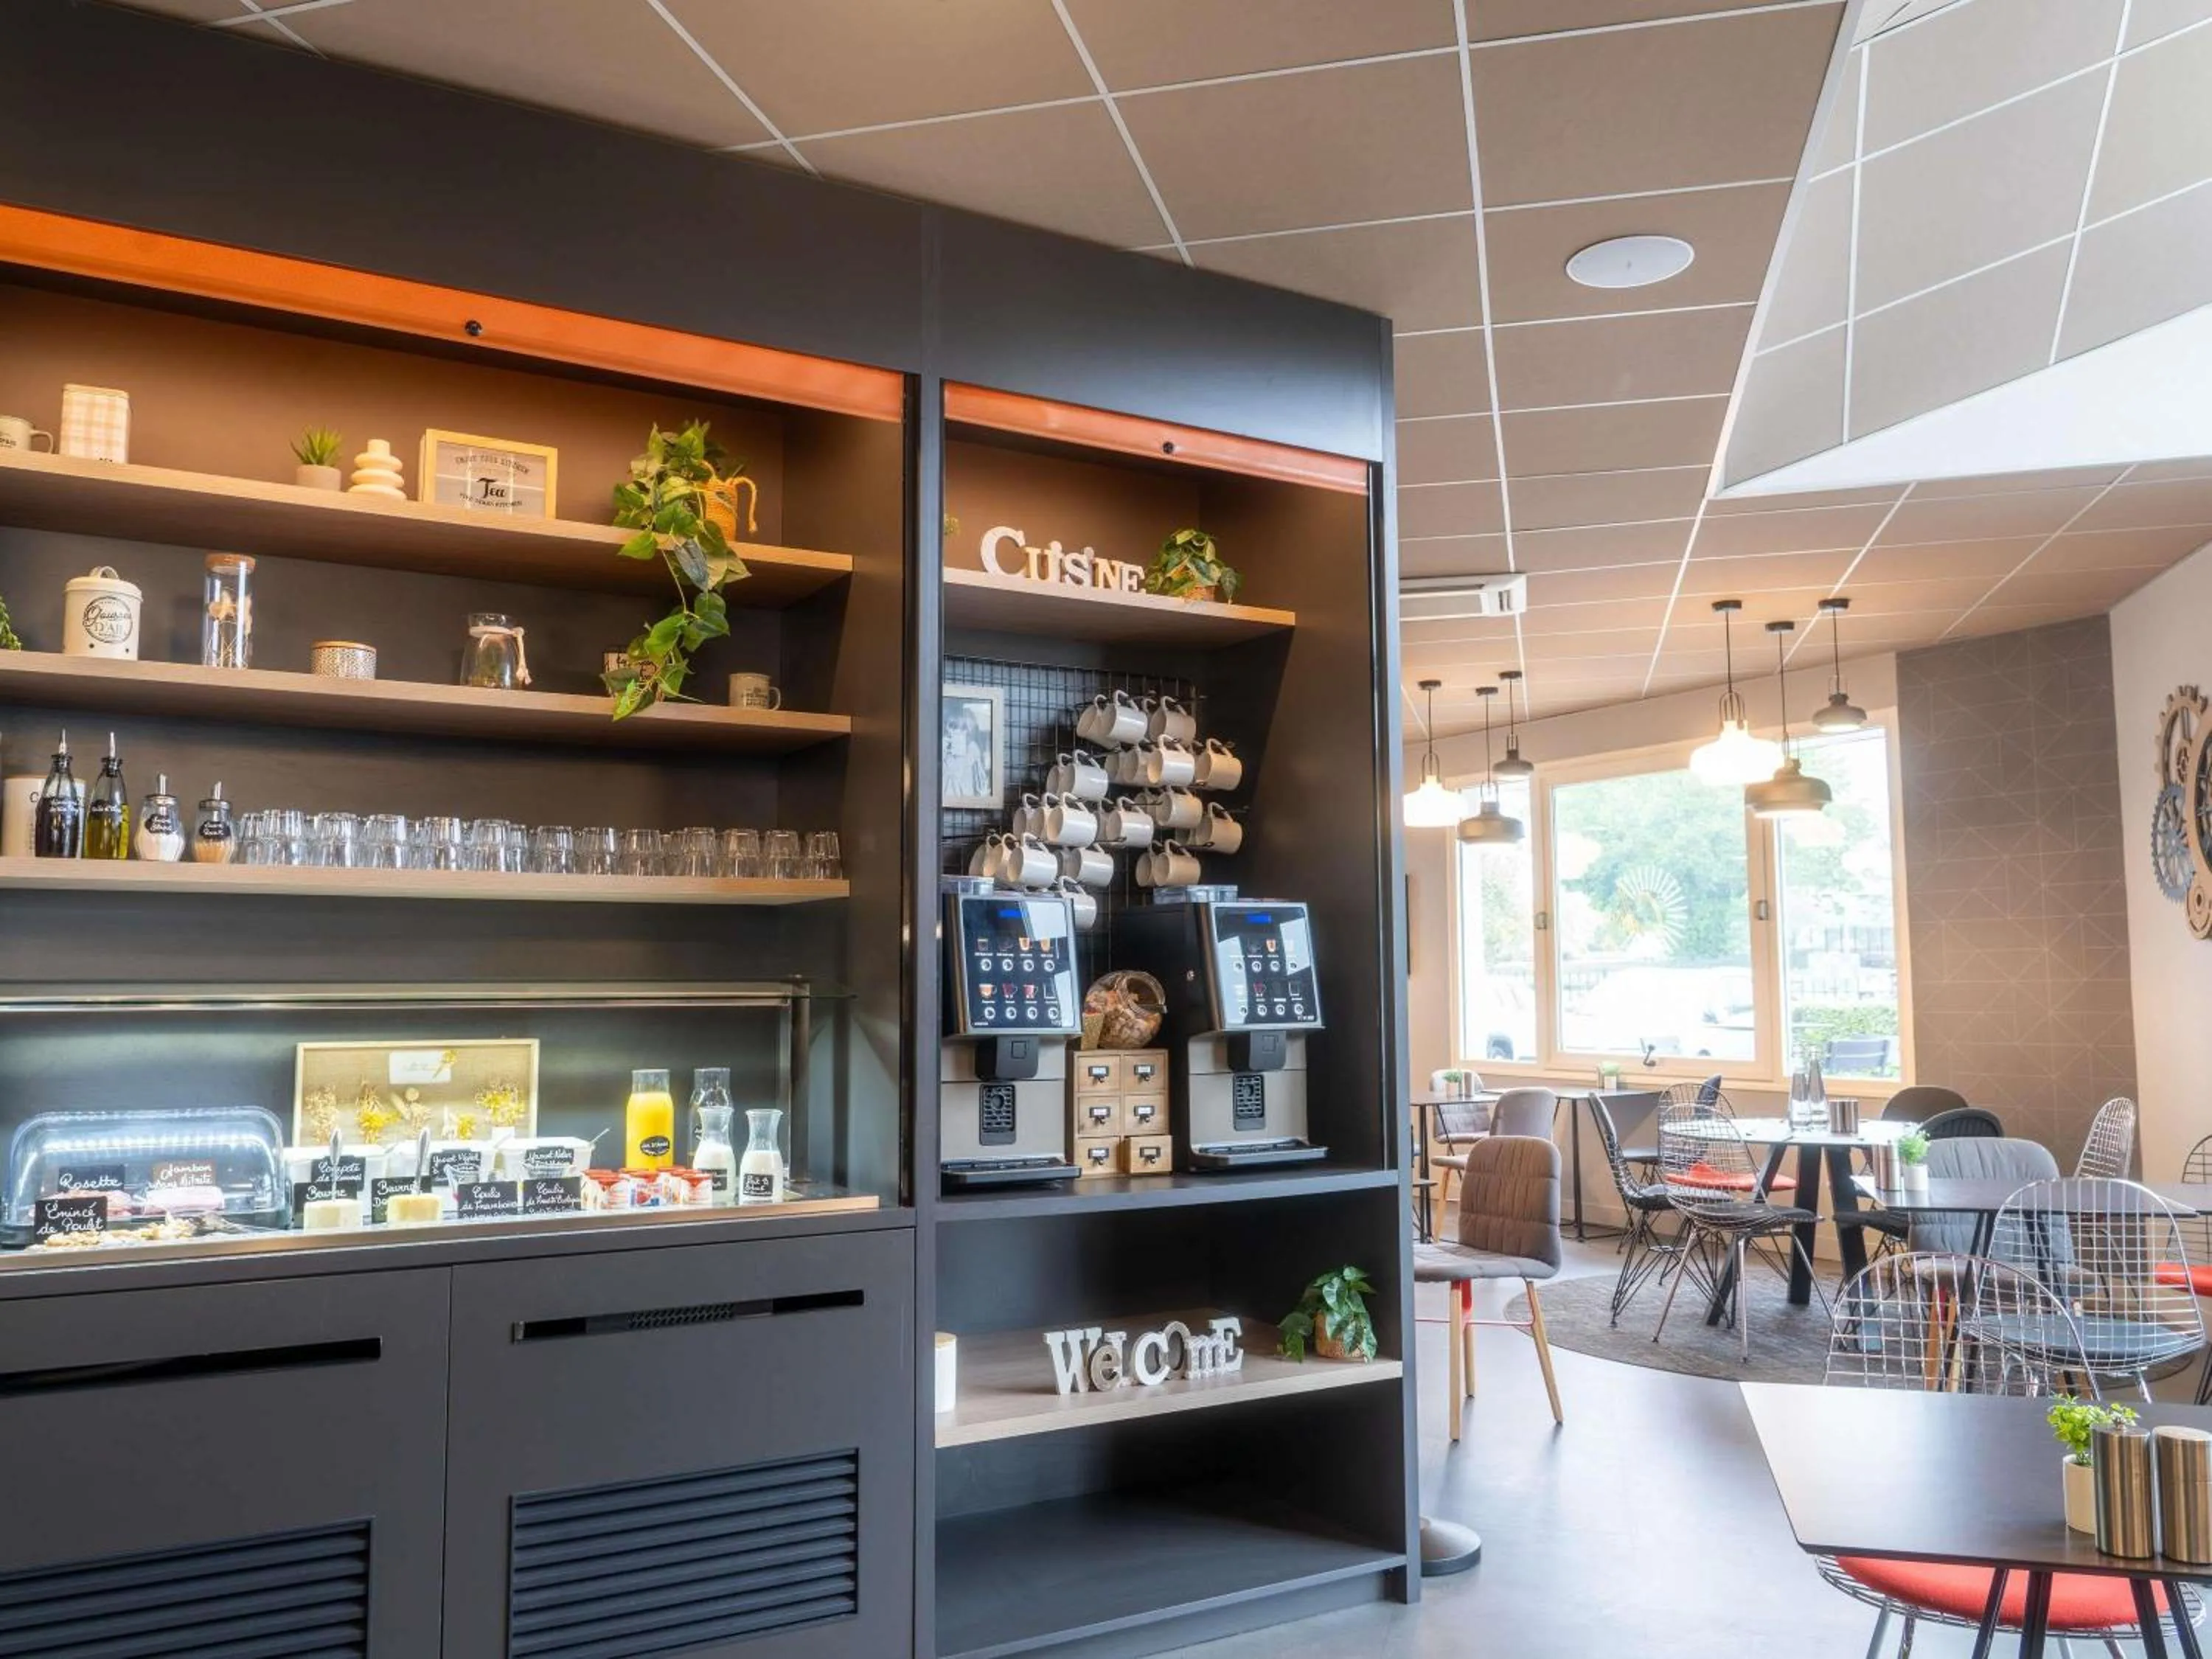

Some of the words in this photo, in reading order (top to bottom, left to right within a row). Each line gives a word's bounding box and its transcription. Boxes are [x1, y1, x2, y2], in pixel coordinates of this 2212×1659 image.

[476, 477, 506, 498] Tea
[60, 1172, 124, 1189] Rosette
[306, 1184, 347, 1200] Beure
[37, 1222, 58, 1235] de
